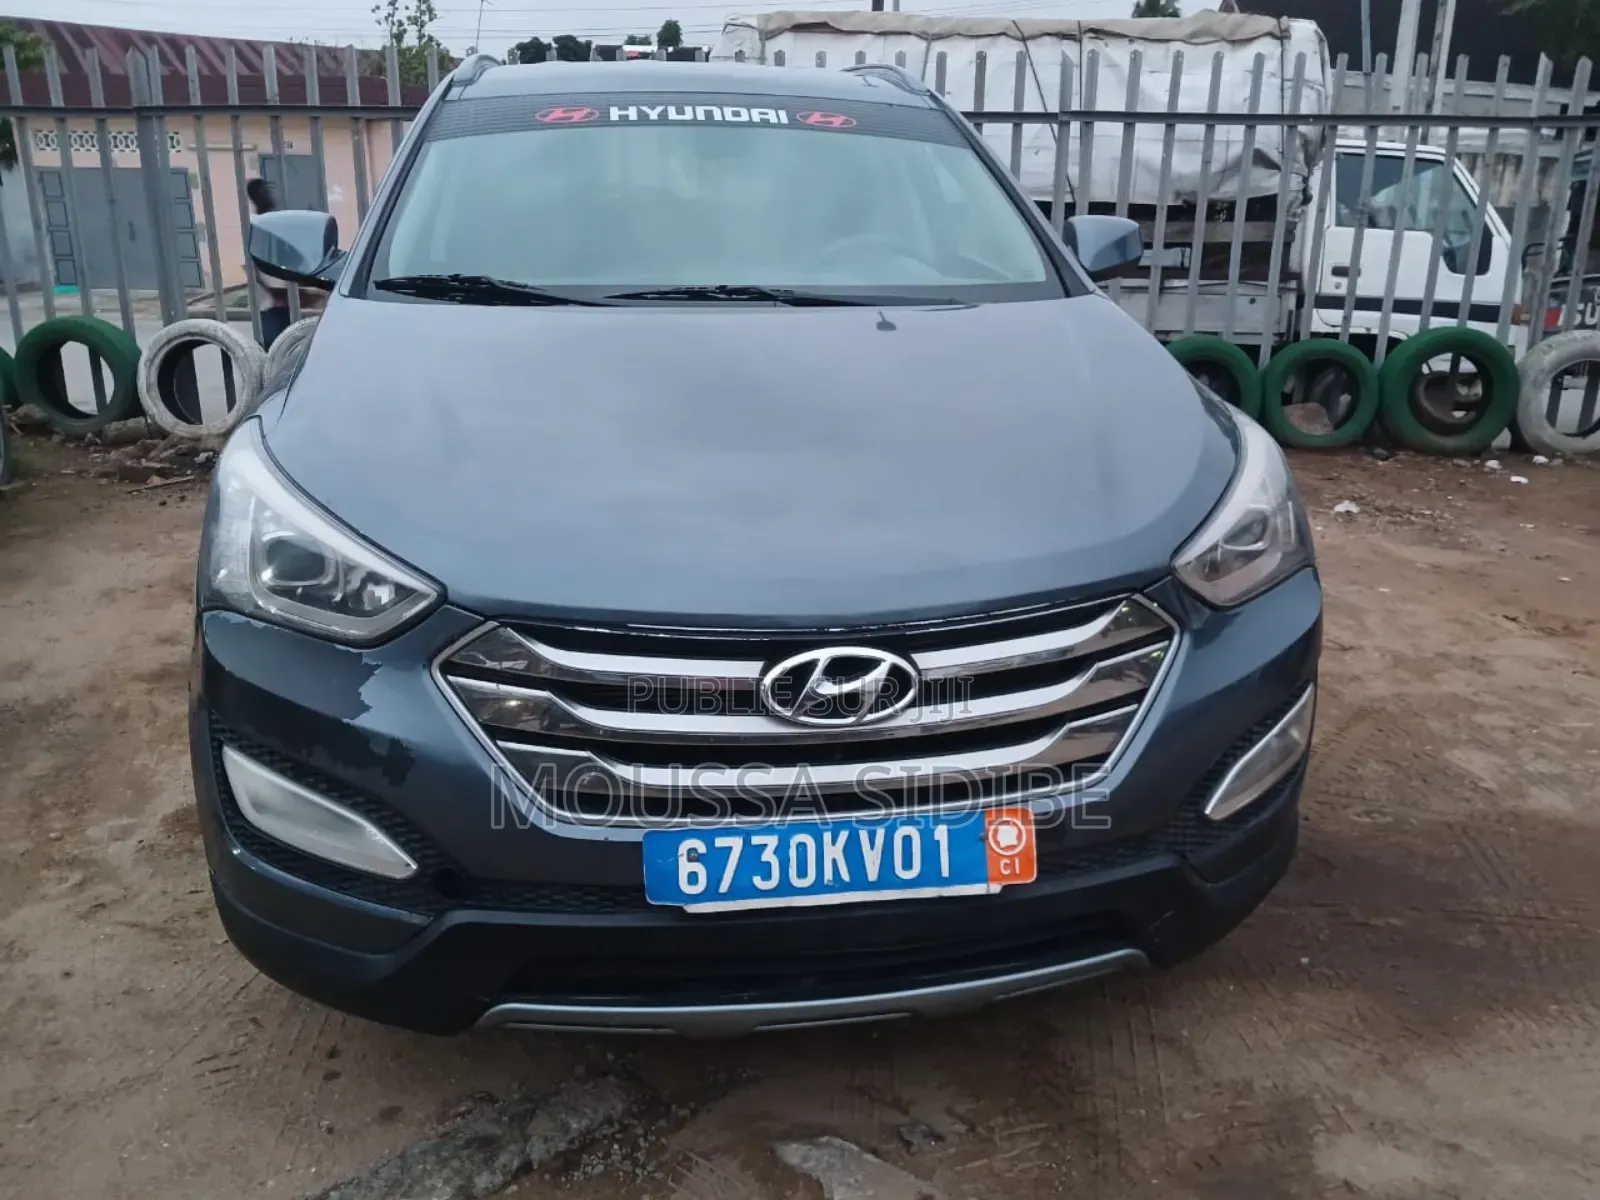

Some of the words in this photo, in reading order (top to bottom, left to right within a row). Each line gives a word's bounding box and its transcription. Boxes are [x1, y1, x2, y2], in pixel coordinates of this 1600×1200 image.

[609, 105, 789, 124] HYUNDAI
[677, 824, 950, 895] 6730KV01
[999, 856, 1021, 876] CI
